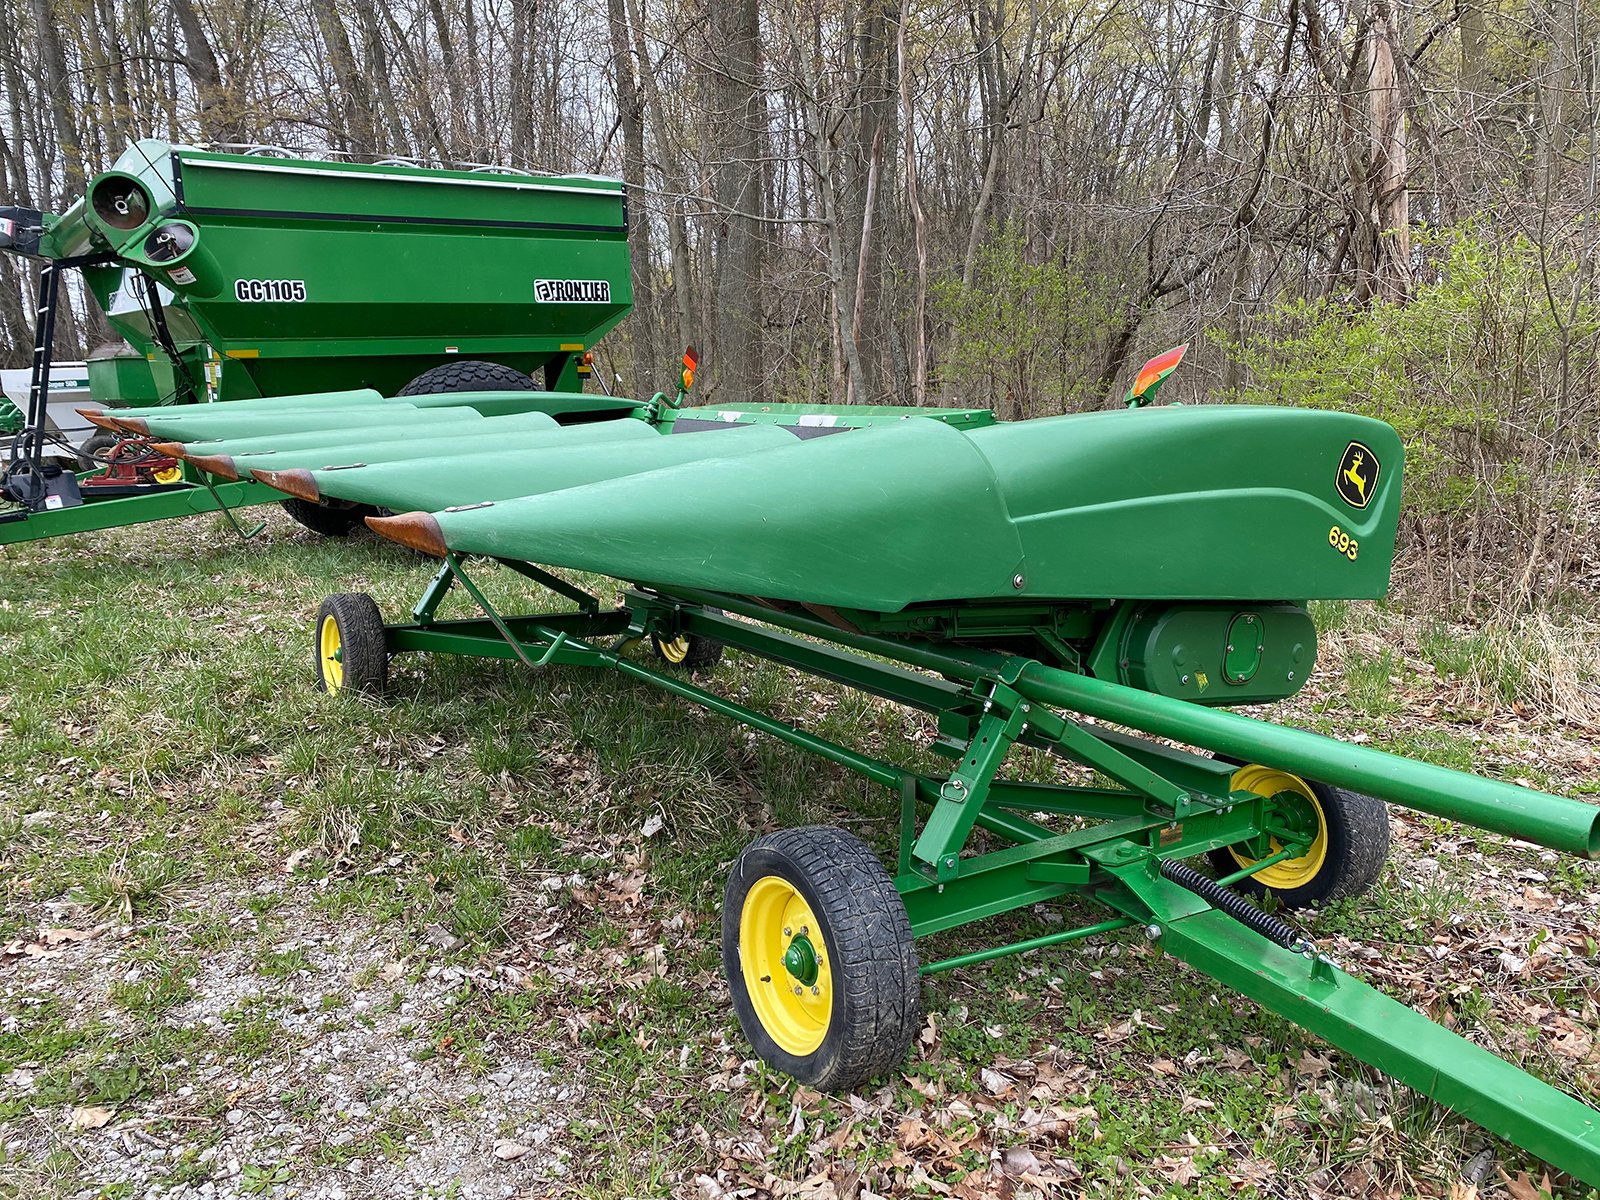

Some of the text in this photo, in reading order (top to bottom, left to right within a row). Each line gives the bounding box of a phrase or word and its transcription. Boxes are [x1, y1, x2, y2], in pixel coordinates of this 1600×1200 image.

[235, 279, 306, 302] GC1105
[548, 280, 610, 302] FRONTIER
[1328, 525, 1359, 562] 693
